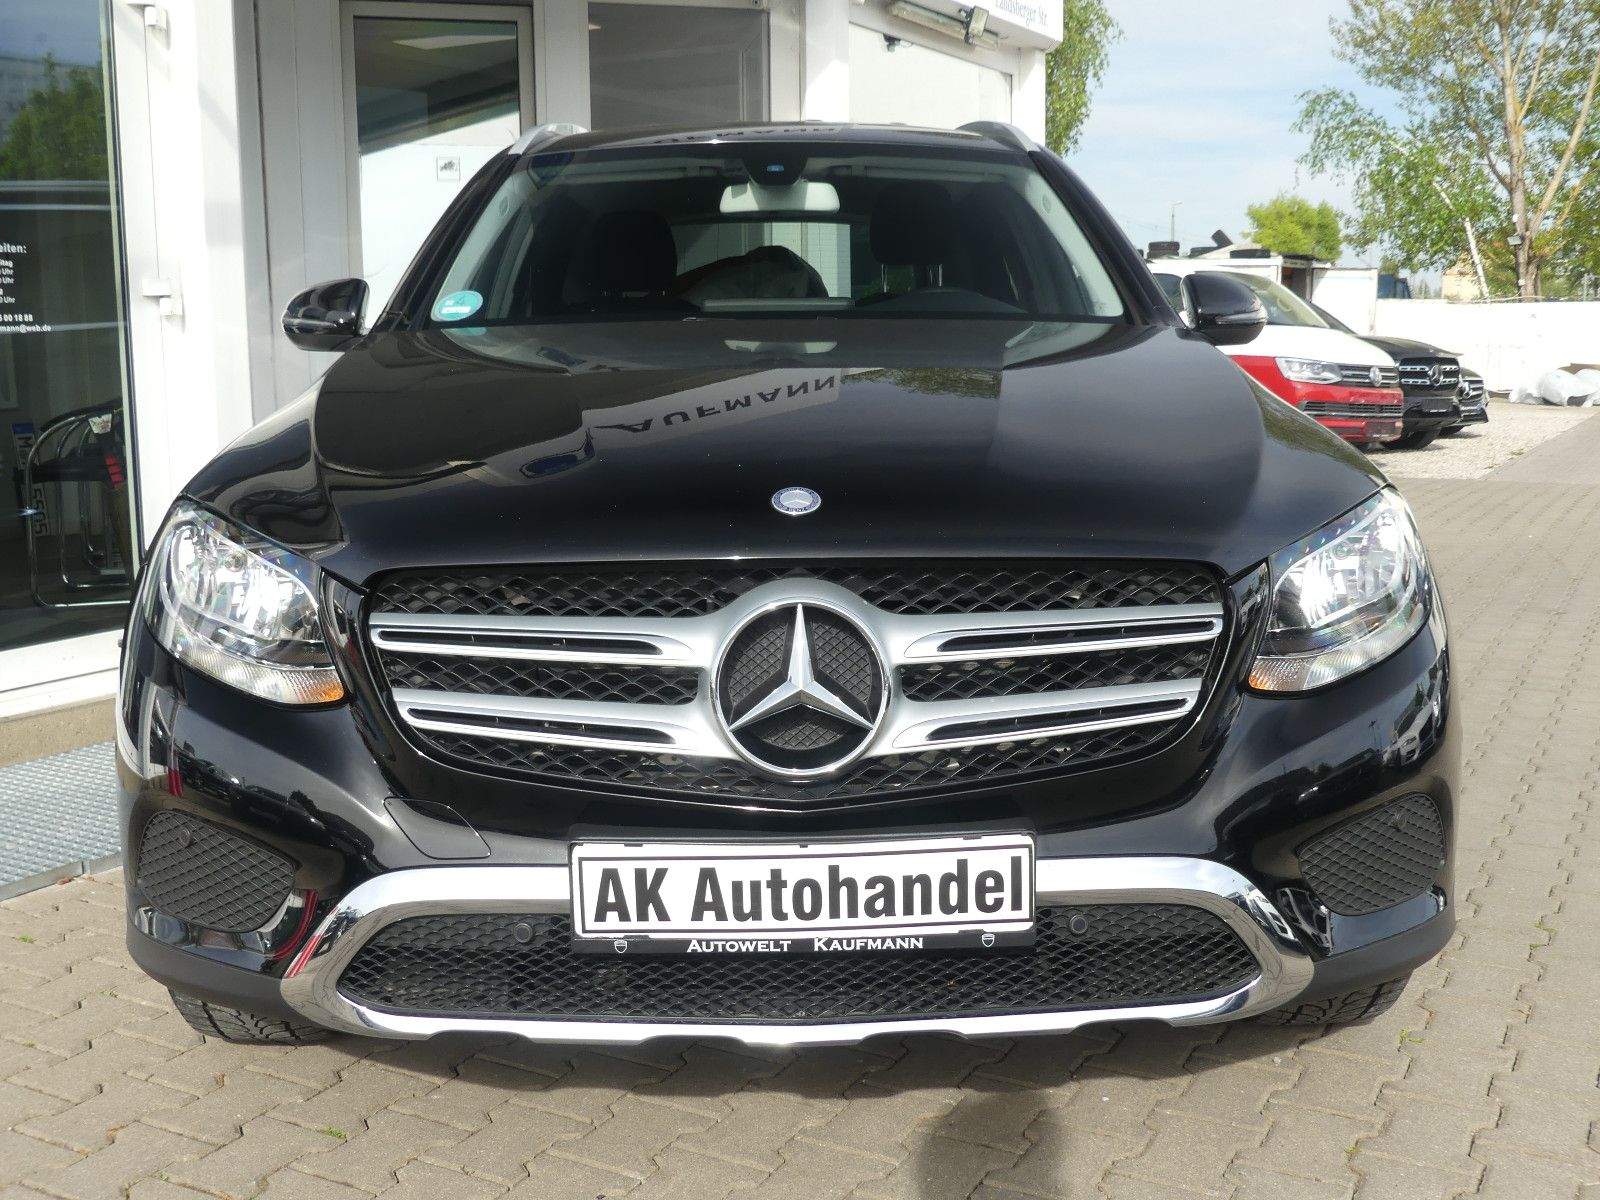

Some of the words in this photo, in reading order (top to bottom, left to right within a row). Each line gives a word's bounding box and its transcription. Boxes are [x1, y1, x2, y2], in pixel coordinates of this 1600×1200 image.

[594, 867, 671, 922] AK
[690, 855, 1022, 922] Autohandel
[686, 939, 792, 953] AUTOWELT
[813, 937, 924, 951] KAUFMANN
